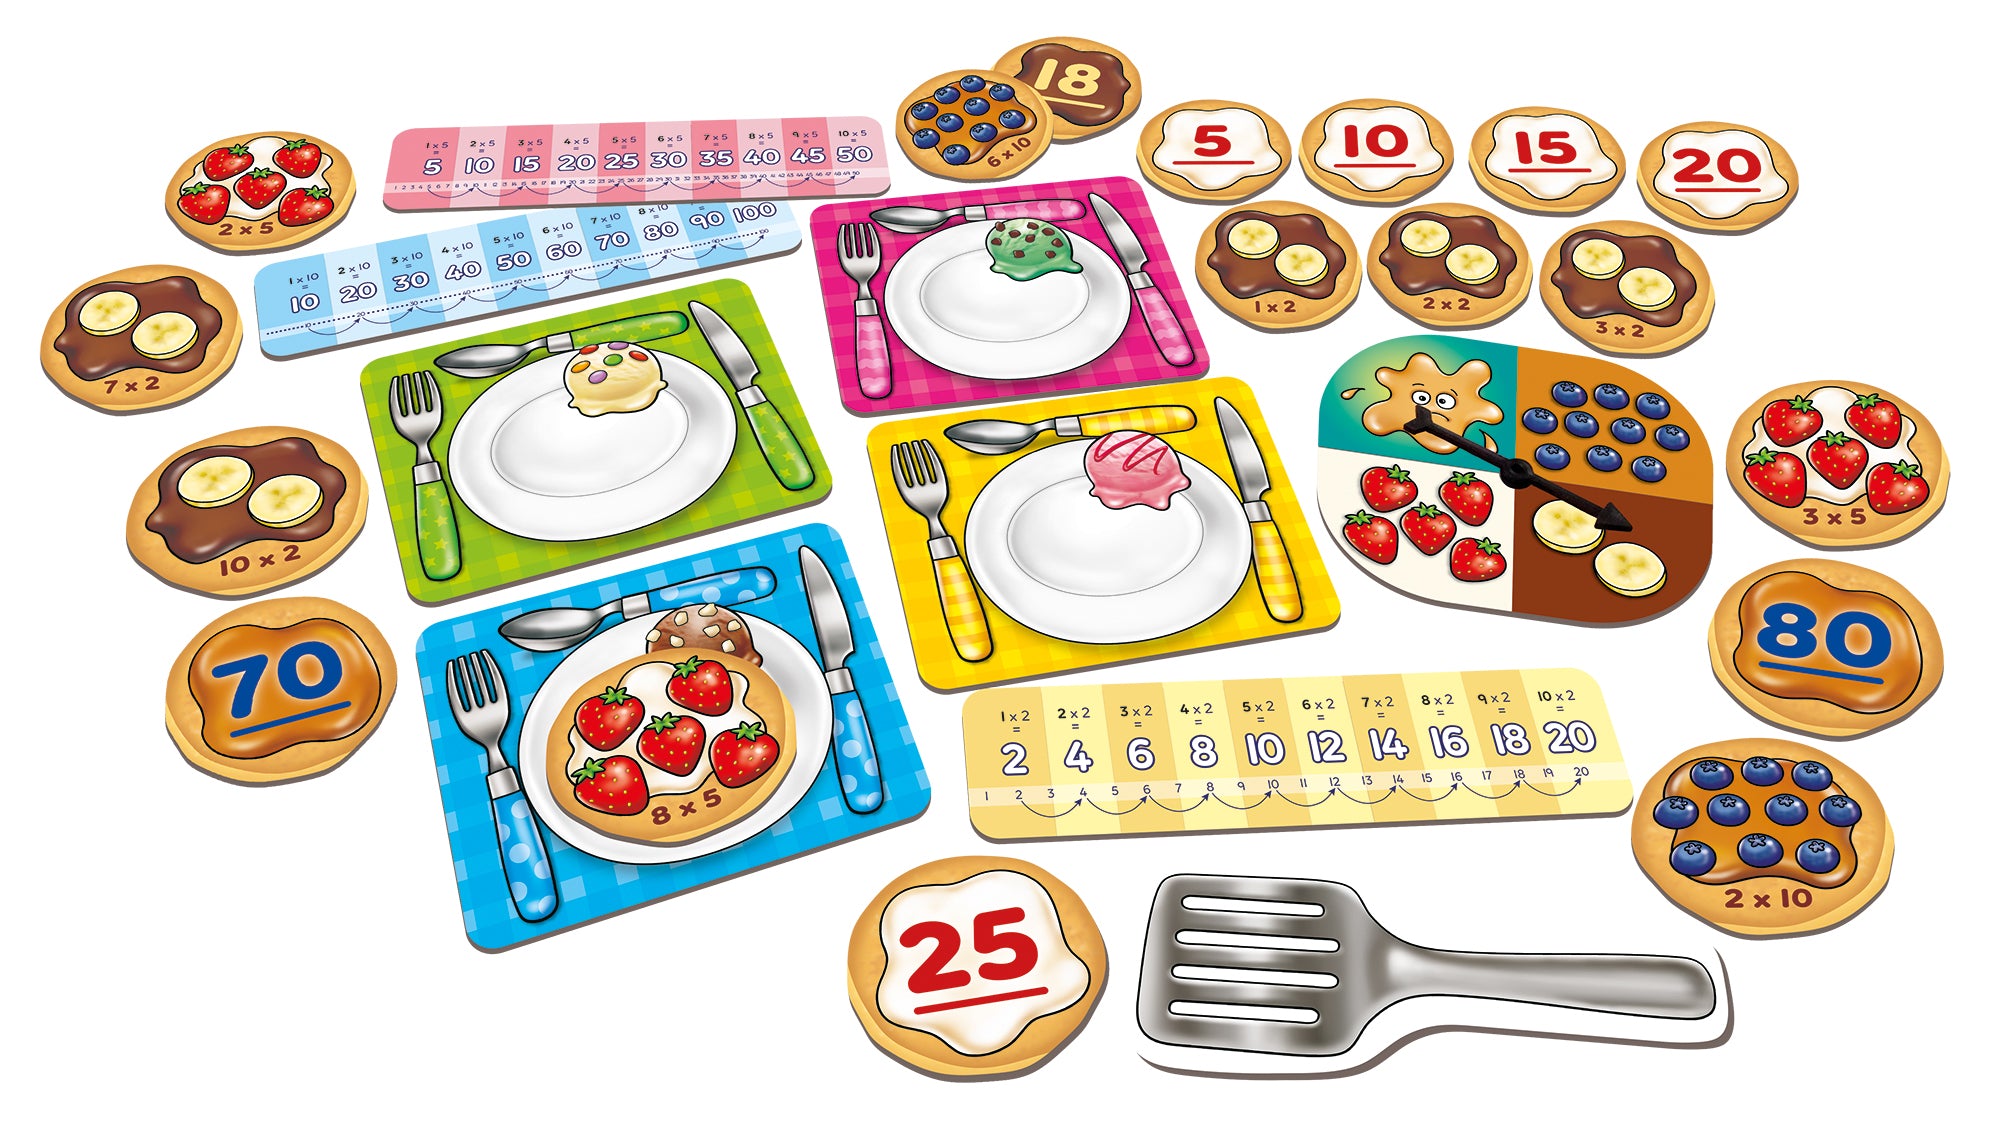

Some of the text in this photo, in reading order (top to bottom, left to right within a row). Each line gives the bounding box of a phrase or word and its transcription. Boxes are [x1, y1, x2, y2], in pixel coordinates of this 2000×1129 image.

[1034, 58, 1101, 96] 18
[470, 140, 477, 148] 2
[1194, 124, 1232, 157] 5
[1344, 124, 1409, 157] 10
[1515, 131, 1577, 164] 15
[988, 137, 1031, 167] 6 x 10
[423, 146, 873, 176] 5 10 15 20 25 30 35 40 45 50
[1673, 148, 1761, 183] 20
[218, 222, 274, 236] 2 x 5
[542, 226, 550, 235] 6
[561, 222, 573, 230] 10
[493, 236, 501, 244] 5
[512, 231, 524, 240] 10
[290, 201, 777, 314] 10 20 30 40 50 60 70 80 90 100
[391, 256, 399, 265] 3
[411, 251, 423, 260] 10
[338, 266, 346, 275] 2
[358, 262, 370, 271] 10
[289, 277, 293, 285] 1
[306, 272, 319, 281] 10
[1255, 300, 1296, 313] 1 x 2
[1423, 297, 1470, 310] 2 x 2
[1596, 321, 1644, 338] 3 x 2
[104, 376, 160, 393] 7 x 2
[1803, 508, 1866, 525] 3 x 5
[220, 545, 301, 576] 10 x 2
[1757, 602, 1891, 668] 80
[211, 641, 343, 719] 70
[1361, 696, 1395, 708] 7 x 2
[1421, 694, 1454, 706] 8 x 2
[1477, 692, 1511, 705] 9 x 2
[1537, 690, 1576, 702] 10 x 2
[1120, 705, 1153, 717] 3 x 2
[1180, 703, 1213, 715] 4 x 2
[1242, 701, 1275, 712] 5 x 2
[1302, 698, 1335, 710] 6 x 2
[1001, 710, 1030, 722] 1 x 2
[1057, 707, 1091, 719] 2 x 2
[1000, 720, 1596, 776] 2 4 6 8 10 12 14 16 18 20
[985, 767, 1590, 801] 1 2 3 4 5 6 7 8 9 10 11 12 13 14 15 16 17 18 19 20
[651, 788, 721, 825] 8 x 5
[1725, 888, 1813, 908] 2 x 10
[899, 907, 1038, 994] 25
